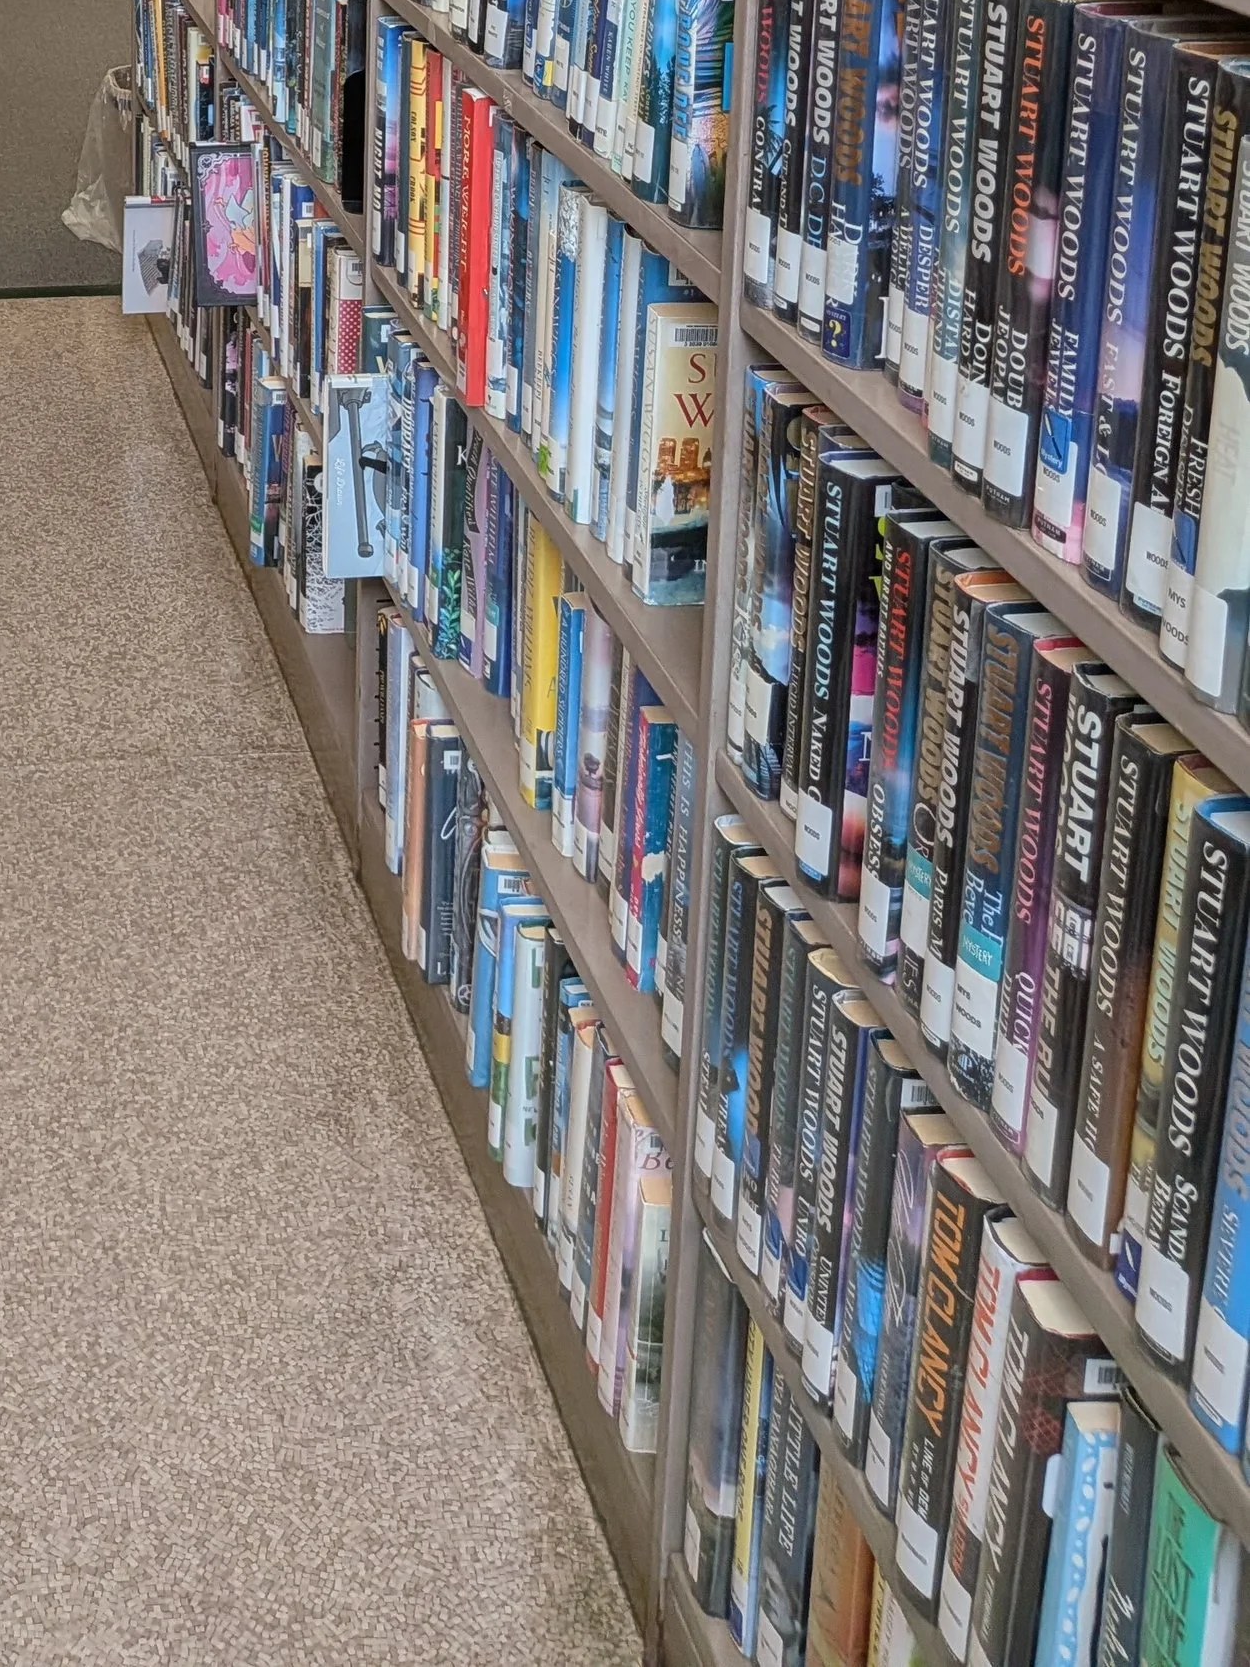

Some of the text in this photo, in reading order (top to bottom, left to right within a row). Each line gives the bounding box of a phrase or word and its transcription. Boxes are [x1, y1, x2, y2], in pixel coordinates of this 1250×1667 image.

[605, 30, 613, 60] KAREN
[625, 35, 634, 73] KEEP
[629, 0, 638, 32] YOU
[785, 25, 803, 127] WOODS
[813, 40, 836, 146] WOODS
[835, 69, 867, 187] WOODS
[899, 62, 919, 169] WOODS
[913, 80, 934, 188] WOODS
[971, 3, 1008, 263] STUART WOODS
[459, 116, 472, 273] MORE WEIGHT
[944, 117, 967, 233] WOODS
[1008, 15, 1045, 276] STUART WOODS
[1058, 33, 1096, 301] STUART WOODS
[1107, 48, 1146, 325] STUART WOODS
[1152, 77, 1210, 483] STUART WOODS FOREIGN
[1192, 107, 1237, 366] STUART WOODS
[1102, 342, 1118, 406] FAST
[1184, 436, 1208, 520] FRESH
[810, 482, 842, 781] STUART WOODS NAKED
[890, 548, 912, 659] STUART
[1168, 587, 1186, 608] MYS
[918, 681, 947, 802] WOODS
[978, 624, 1020, 754] STUART
[929, 609, 971, 929] STUART WOODS PARIS
[1017, 677, 1051, 924] STUART WOODS
[1064, 706, 1101, 882] STUART
[674, 826, 689, 938] HAPPINESS
[983, 888, 1003, 924] The
[1088, 755, 1138, 1115] STUART WOODS SAFE
[963, 939, 993, 968] MYSTERY
[1041, 964, 1060, 1039] THE
[1167, 841, 1227, 1158] STUART WOODS
[956, 1003, 981, 1028] WOODS
[800, 985, 827, 1183] STUART WOODS
[815, 1030, 848, 1234] STUART WOODS
[915, 1192, 966, 1435] TOM CLANCY
[958, 1256, 1000, 1501] TOM CLANCY
[923, 1437, 934, 1463] LINE
[984, 1314, 1029, 1573] TOM CLANCY
[779, 1491, 796, 1557] LIFE
